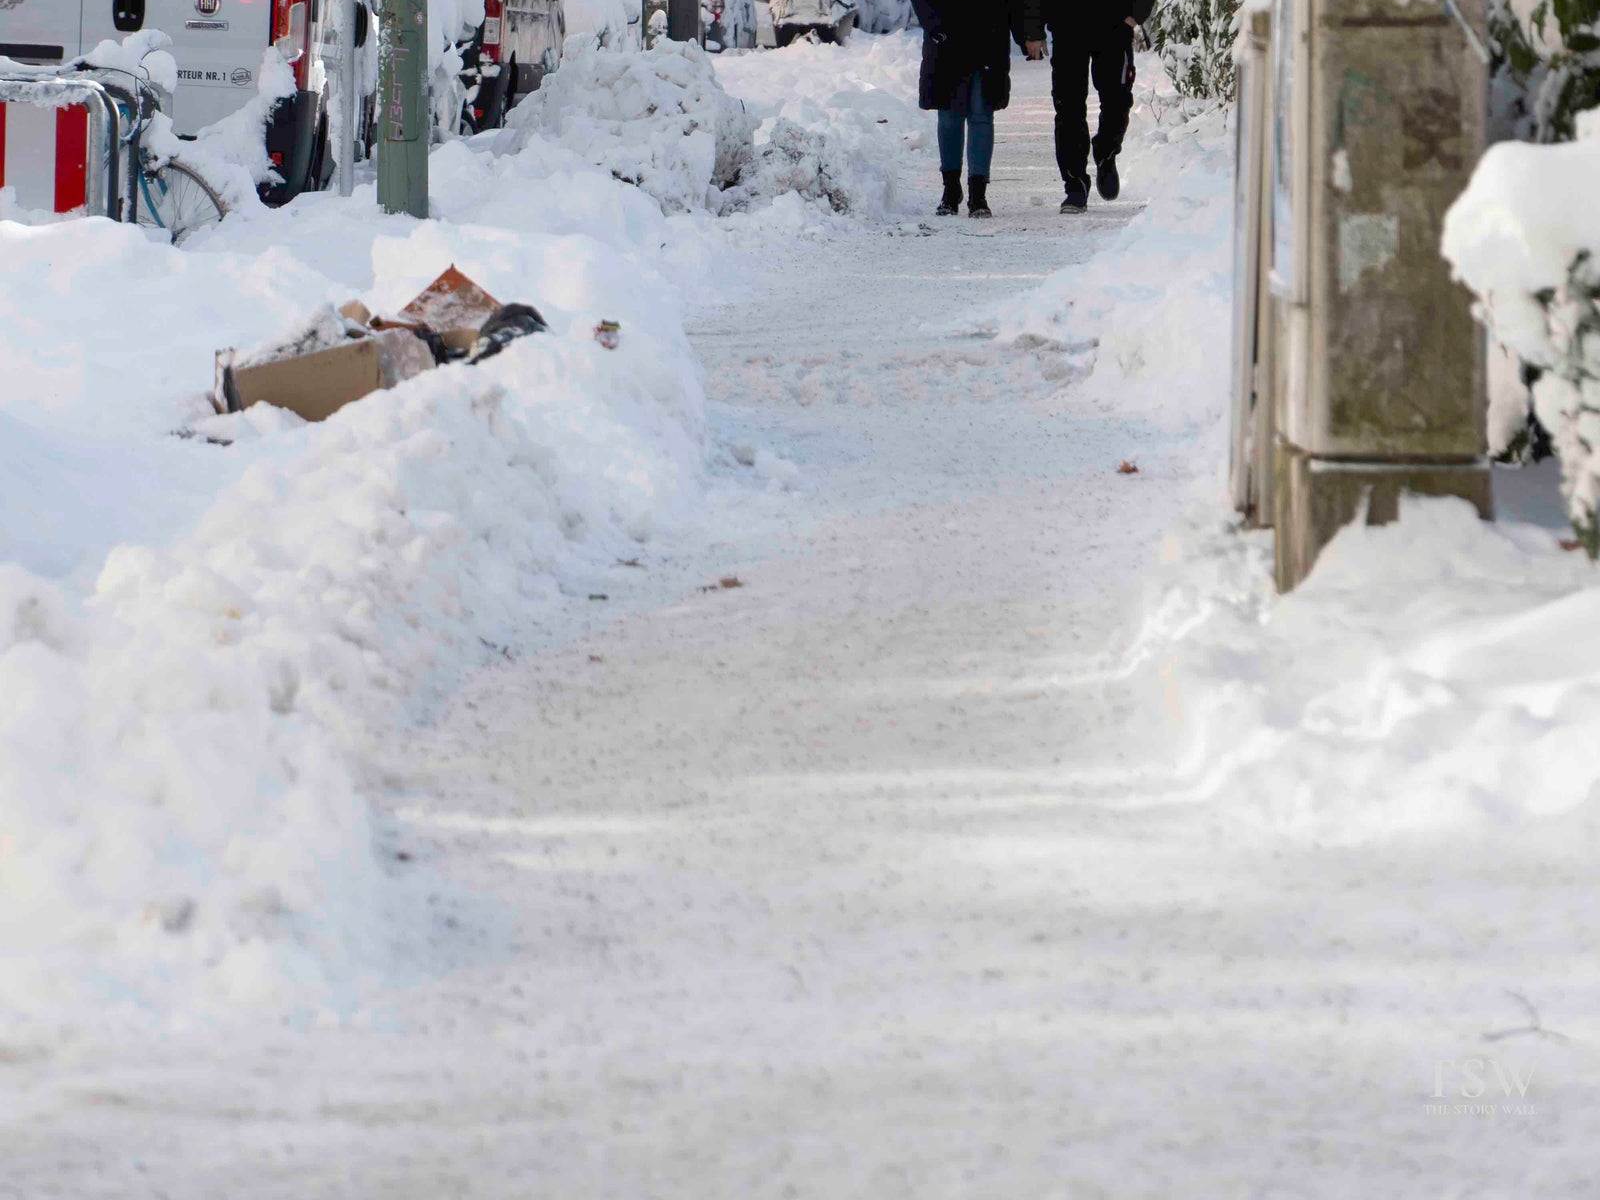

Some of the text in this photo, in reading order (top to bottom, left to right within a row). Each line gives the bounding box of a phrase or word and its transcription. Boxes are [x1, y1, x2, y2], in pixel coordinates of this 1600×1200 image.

[177, 69, 203, 81] RTEUR
[205, 71, 220, 81] NR.
[223, 72, 226, 81] 1
